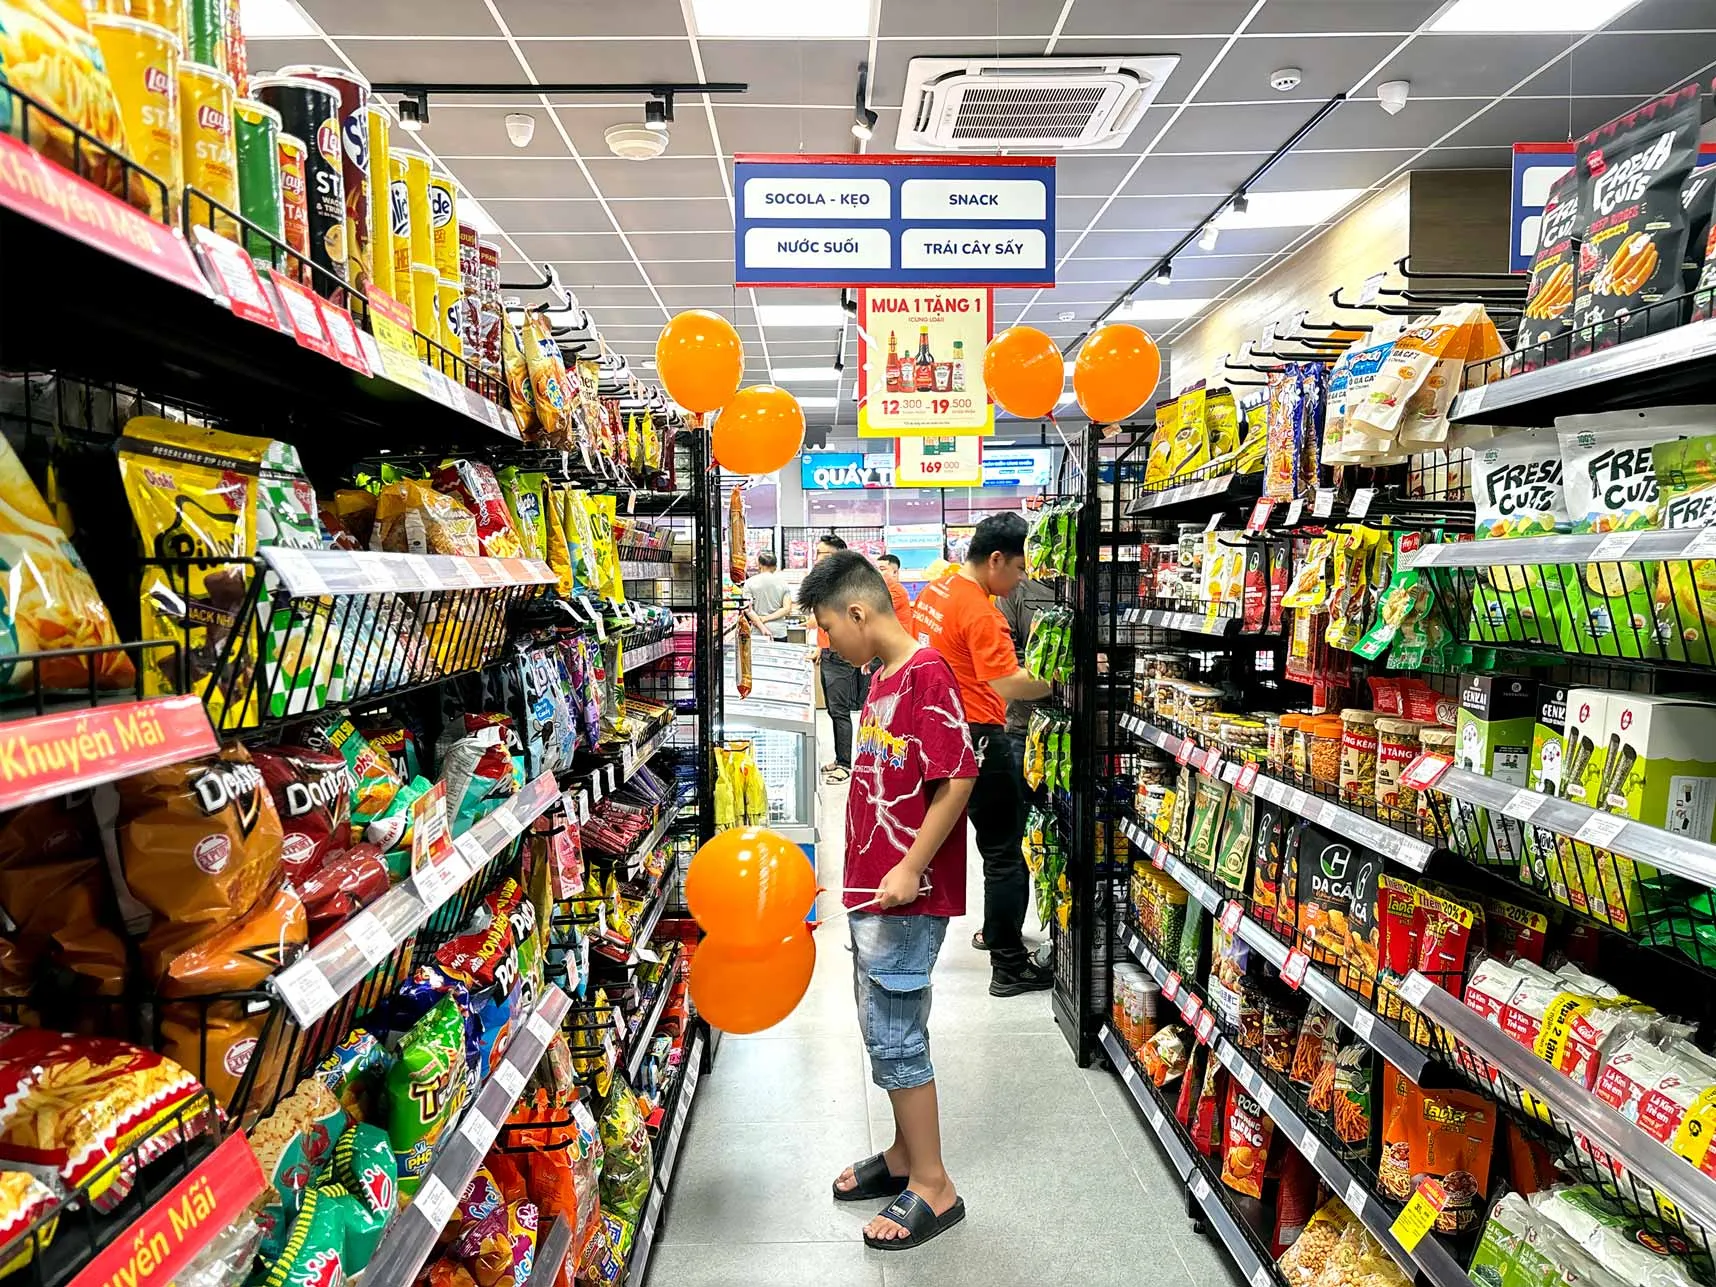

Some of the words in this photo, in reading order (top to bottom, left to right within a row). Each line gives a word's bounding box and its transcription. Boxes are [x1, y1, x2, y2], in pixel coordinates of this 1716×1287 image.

[1593, 130, 1677, 212] FRESH
[765, 193, 826, 205] SOCOLA
[840, 193, 870, 208] KẸO
[949, 194, 998, 206] SNACK
[1600, 174, 1652, 216] CUTS
[777, 238, 820, 253] NƯỚC
[823, 237, 859, 253] SUỐI
[924, 240, 958, 254] TRÁI
[962, 240, 991, 254] CÂY
[995, 239, 1023, 254] SẤY
[872, 298, 909, 313] MUA
[914, 298, 920, 313] 1
[924, 294, 970, 317] TẶNG
[974, 298, 981, 313] 1
[152, 446, 201, 463] RESEALABLE
[203, 457, 217, 465] ZIP
[217, 459, 237, 469] LOCK
[921, 462, 942, 473] 169
[1500, 486, 1556, 516] CUTS
[1463, 690, 1487, 705] GENKAI
[0, 716, 109, 782] Khuyến
[114, 706, 165, 752] Mãi
[287, 766, 358, 816] Doritos
[1313, 875, 1329, 894] DA
[1331, 881, 1355, 900] CÁ
[1443, 901, 1459, 919] 20%
[1508, 905, 1529, 923] 20%
[1557, 1000, 1580, 1024] Mua
[1552, 1026, 1562, 1037] 2
[1237, 1094, 1260, 1117] POCA
[1660, 1099, 1675, 1114] Kim
[1656, 1110, 1669, 1124] em
[168, 1176, 217, 1242] Mãi
